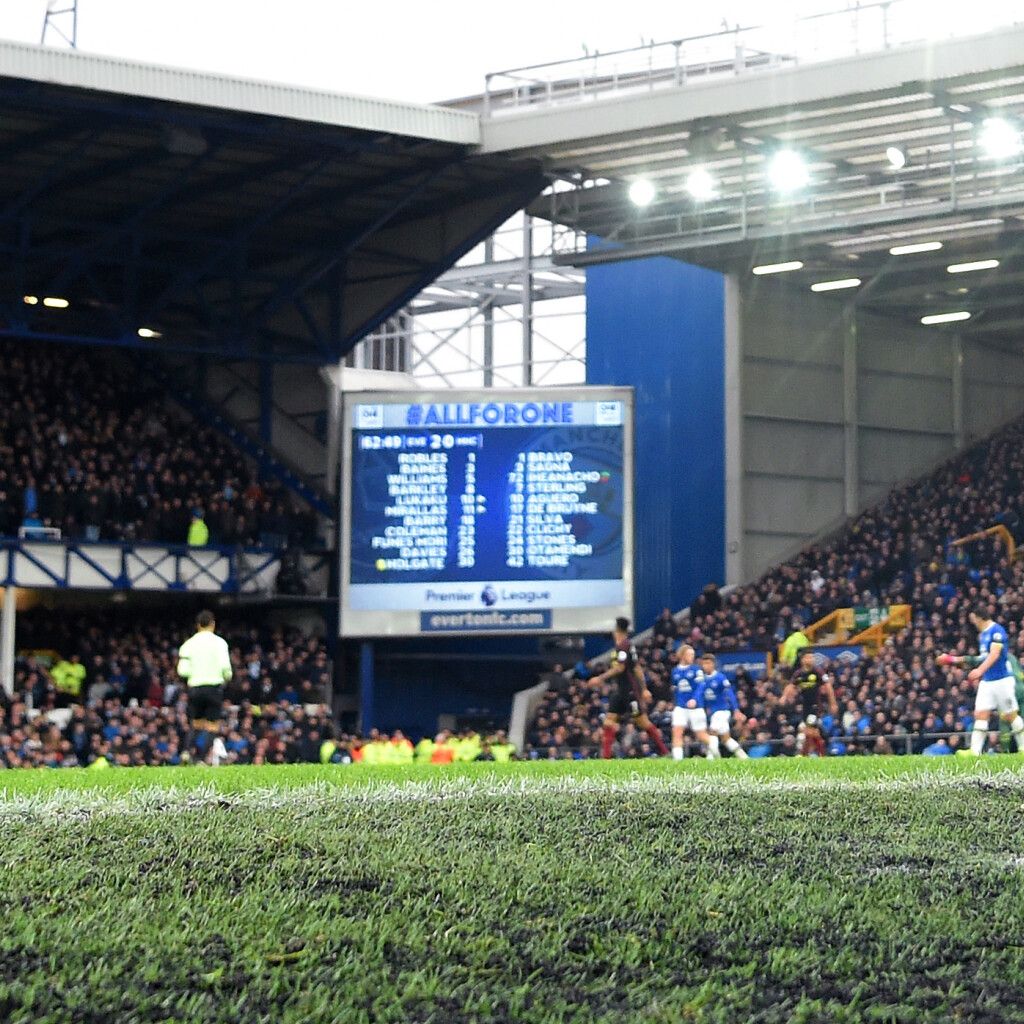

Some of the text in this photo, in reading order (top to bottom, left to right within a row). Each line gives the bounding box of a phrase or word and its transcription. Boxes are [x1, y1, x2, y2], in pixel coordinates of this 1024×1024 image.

[407, 403, 574, 425] #ALLFORONE
[398, 453, 448, 463] ROBLES
[528, 452, 573, 462] BRAVO
[400, 464, 447, 473] BAINES
[527, 462, 571, 471] SAGNA
[387, 474, 447, 484] WILLIAMS
[527, 472, 600, 482] IHEANACHO
[389, 485, 447, 495] BARKLEY
[527, 482, 586, 493] STERLING
[396, 495, 447, 504] LUKAKU
[385, 505, 447, 516] MIRALLAS
[527, 504, 545, 513] DE
[547, 502, 598, 513] BRUYNE
[404, 515, 446, 526] BARRY
[526, 514, 563, 523] SILVA
[385, 526, 447, 536] COLEMAN
[526, 524, 572, 533] CLICHY
[372, 537, 413, 548] FUNES
[416, 537, 447, 547] MORI
[527, 534, 576, 545] STONES
[400, 547, 447, 557] DAVIES
[527, 544, 592, 555] OTAMENDI
[387, 558, 444, 569] HOLGATE
[528, 555, 569, 567] TOURE
[426, 588, 550, 602] Premier League
